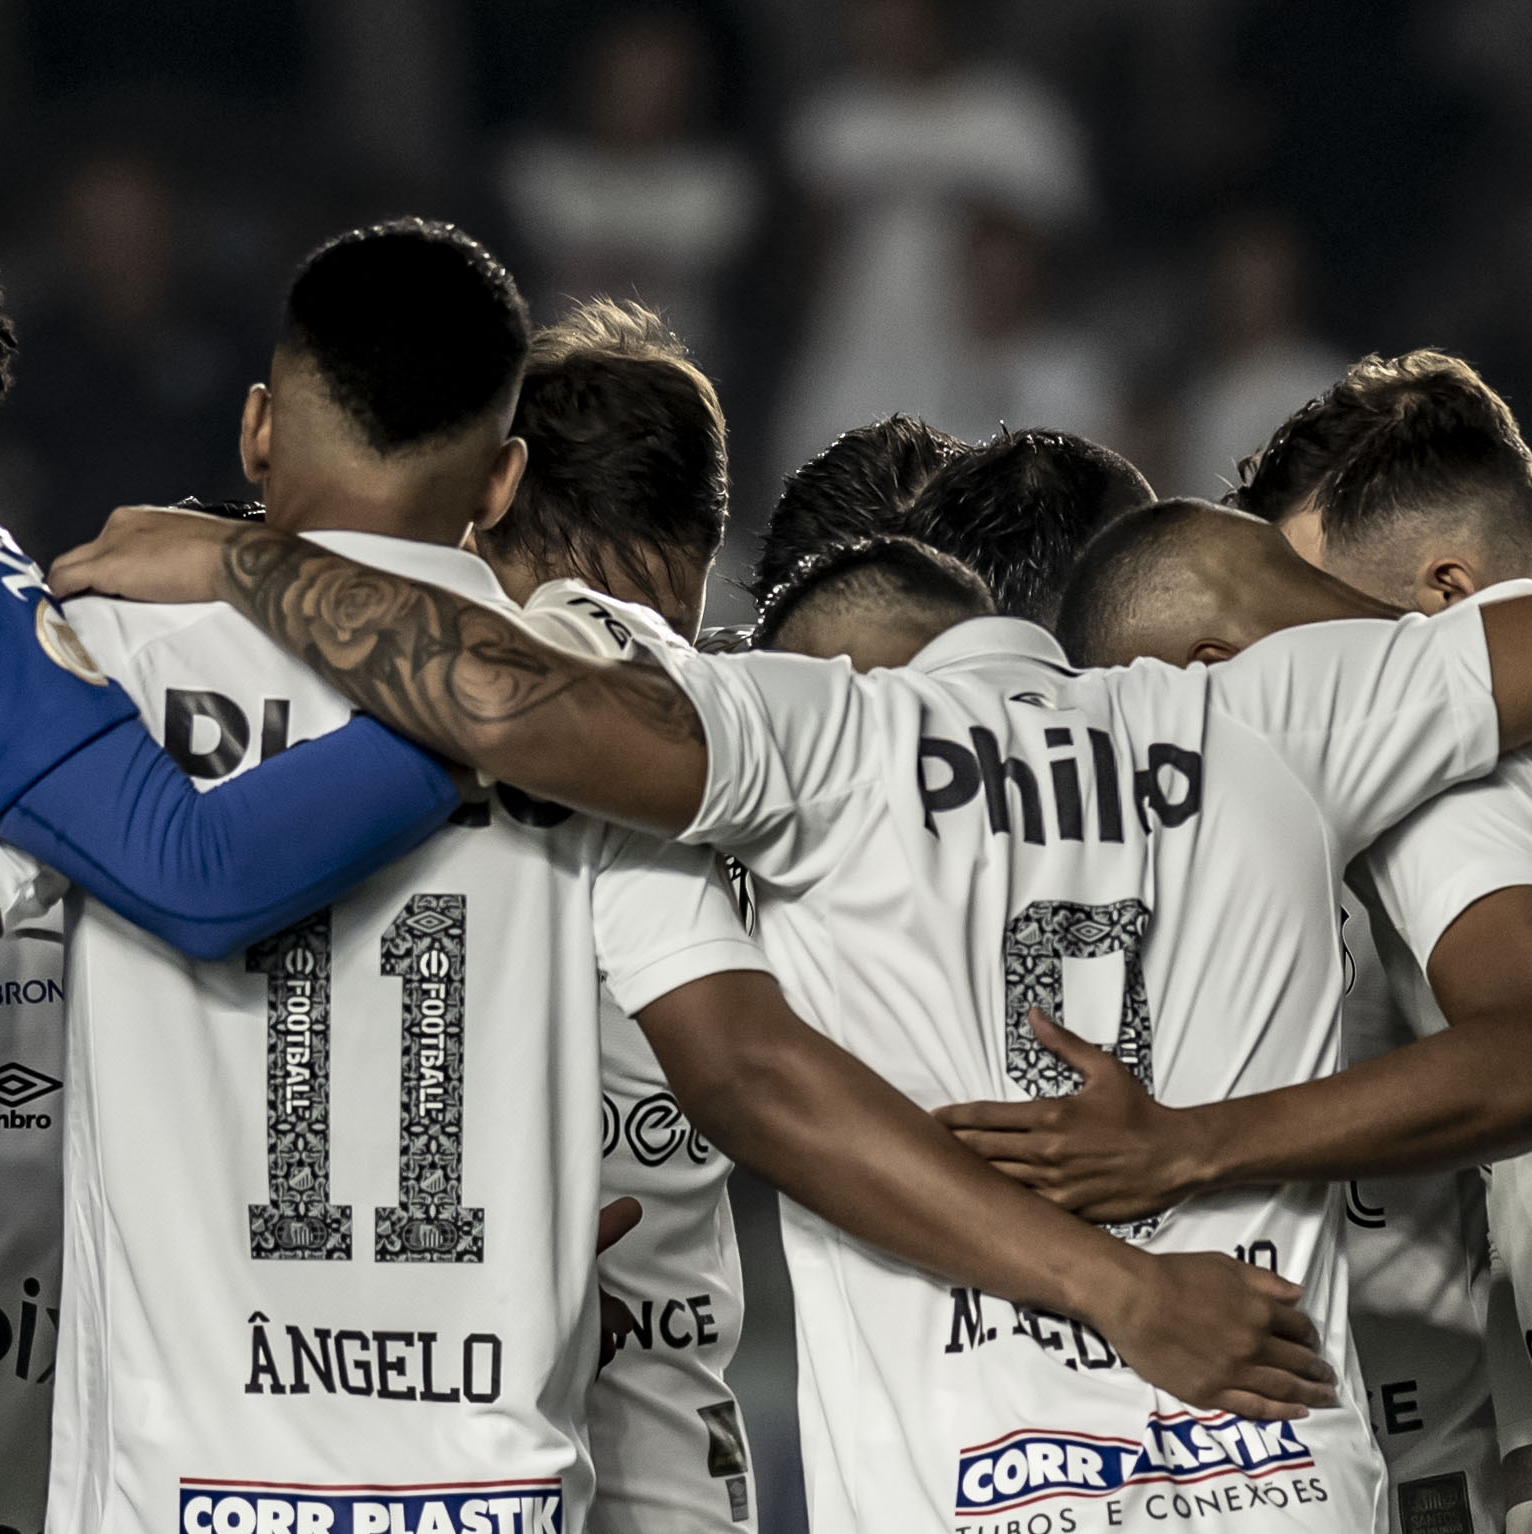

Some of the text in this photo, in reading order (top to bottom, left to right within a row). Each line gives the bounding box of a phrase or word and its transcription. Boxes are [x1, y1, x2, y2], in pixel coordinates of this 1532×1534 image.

[245, 894, 486, 1263] 11
[245, 1311, 504, 1405] ÂNGELO
[1107, 1501, 1123, 1526] E
[1146, 1477, 1328, 1521] CONEXÕES
